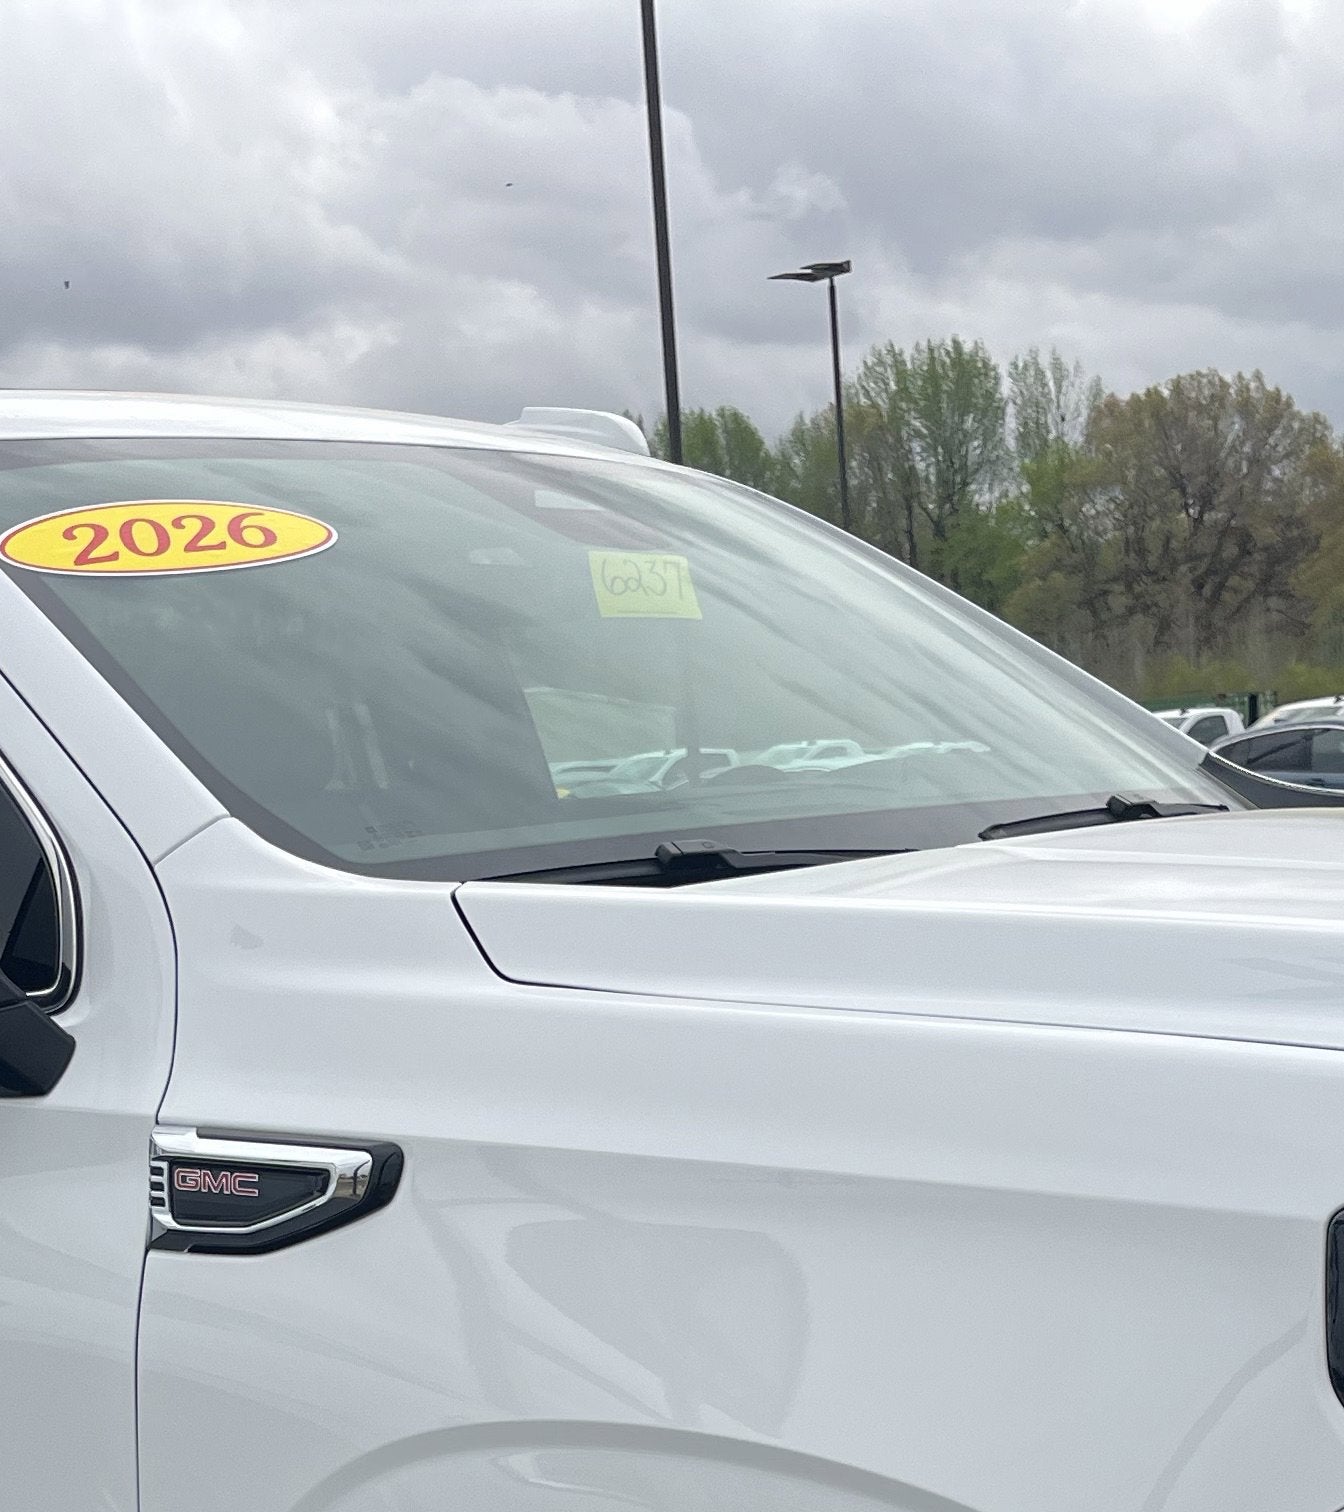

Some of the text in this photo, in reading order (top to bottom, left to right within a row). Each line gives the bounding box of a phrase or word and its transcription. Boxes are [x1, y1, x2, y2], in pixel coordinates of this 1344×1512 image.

[61, 511, 278, 567] 2026
[601, 558, 684, 601] 6237
[173, 1167, 259, 1197] GMC
